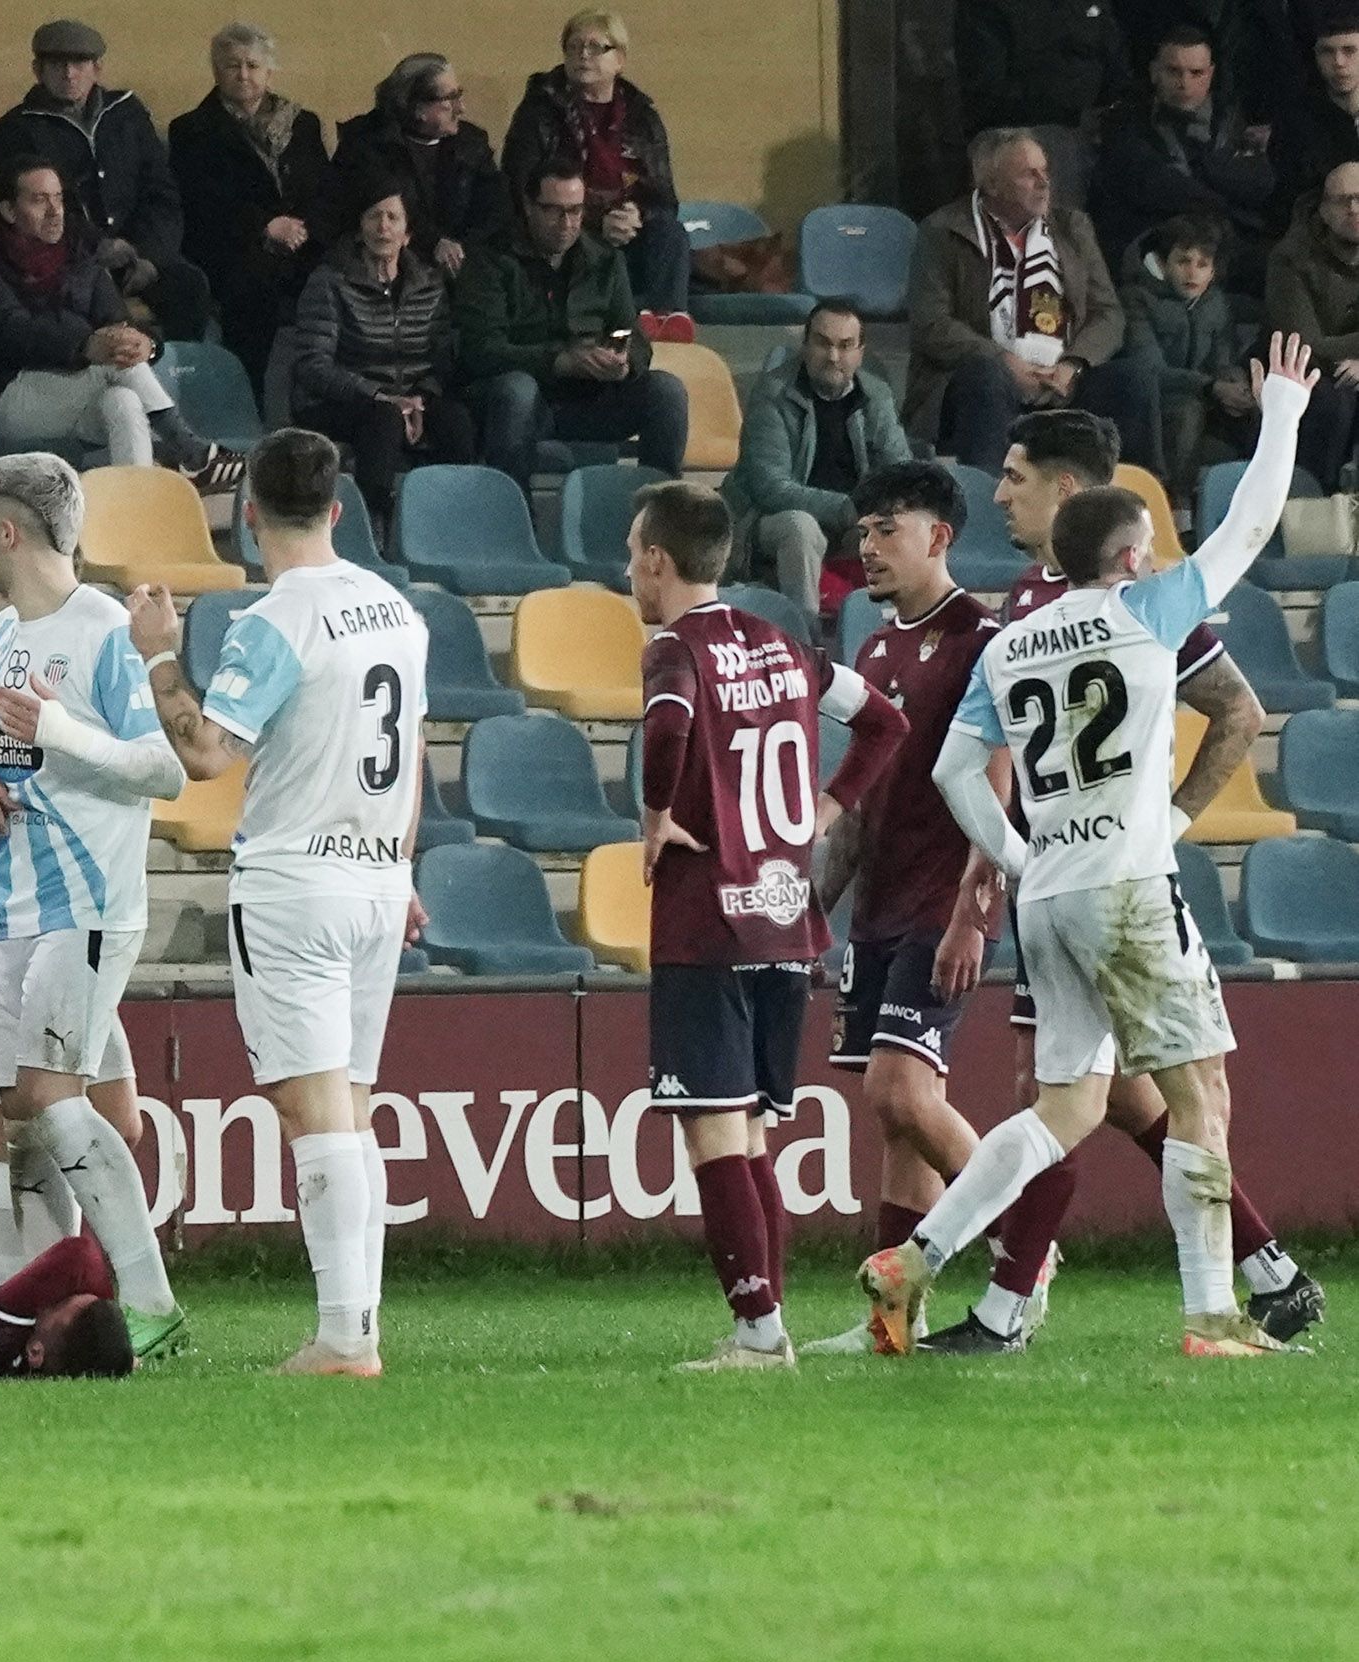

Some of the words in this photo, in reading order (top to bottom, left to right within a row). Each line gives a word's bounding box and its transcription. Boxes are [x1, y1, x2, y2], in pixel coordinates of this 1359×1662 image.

[1006, 617, 1112, 663] SAMANES
[357, 663, 402, 796] 3
[728, 720, 816, 853] 10
[1006, 660, 1133, 802] 22
[839, 941, 855, 994] 9
